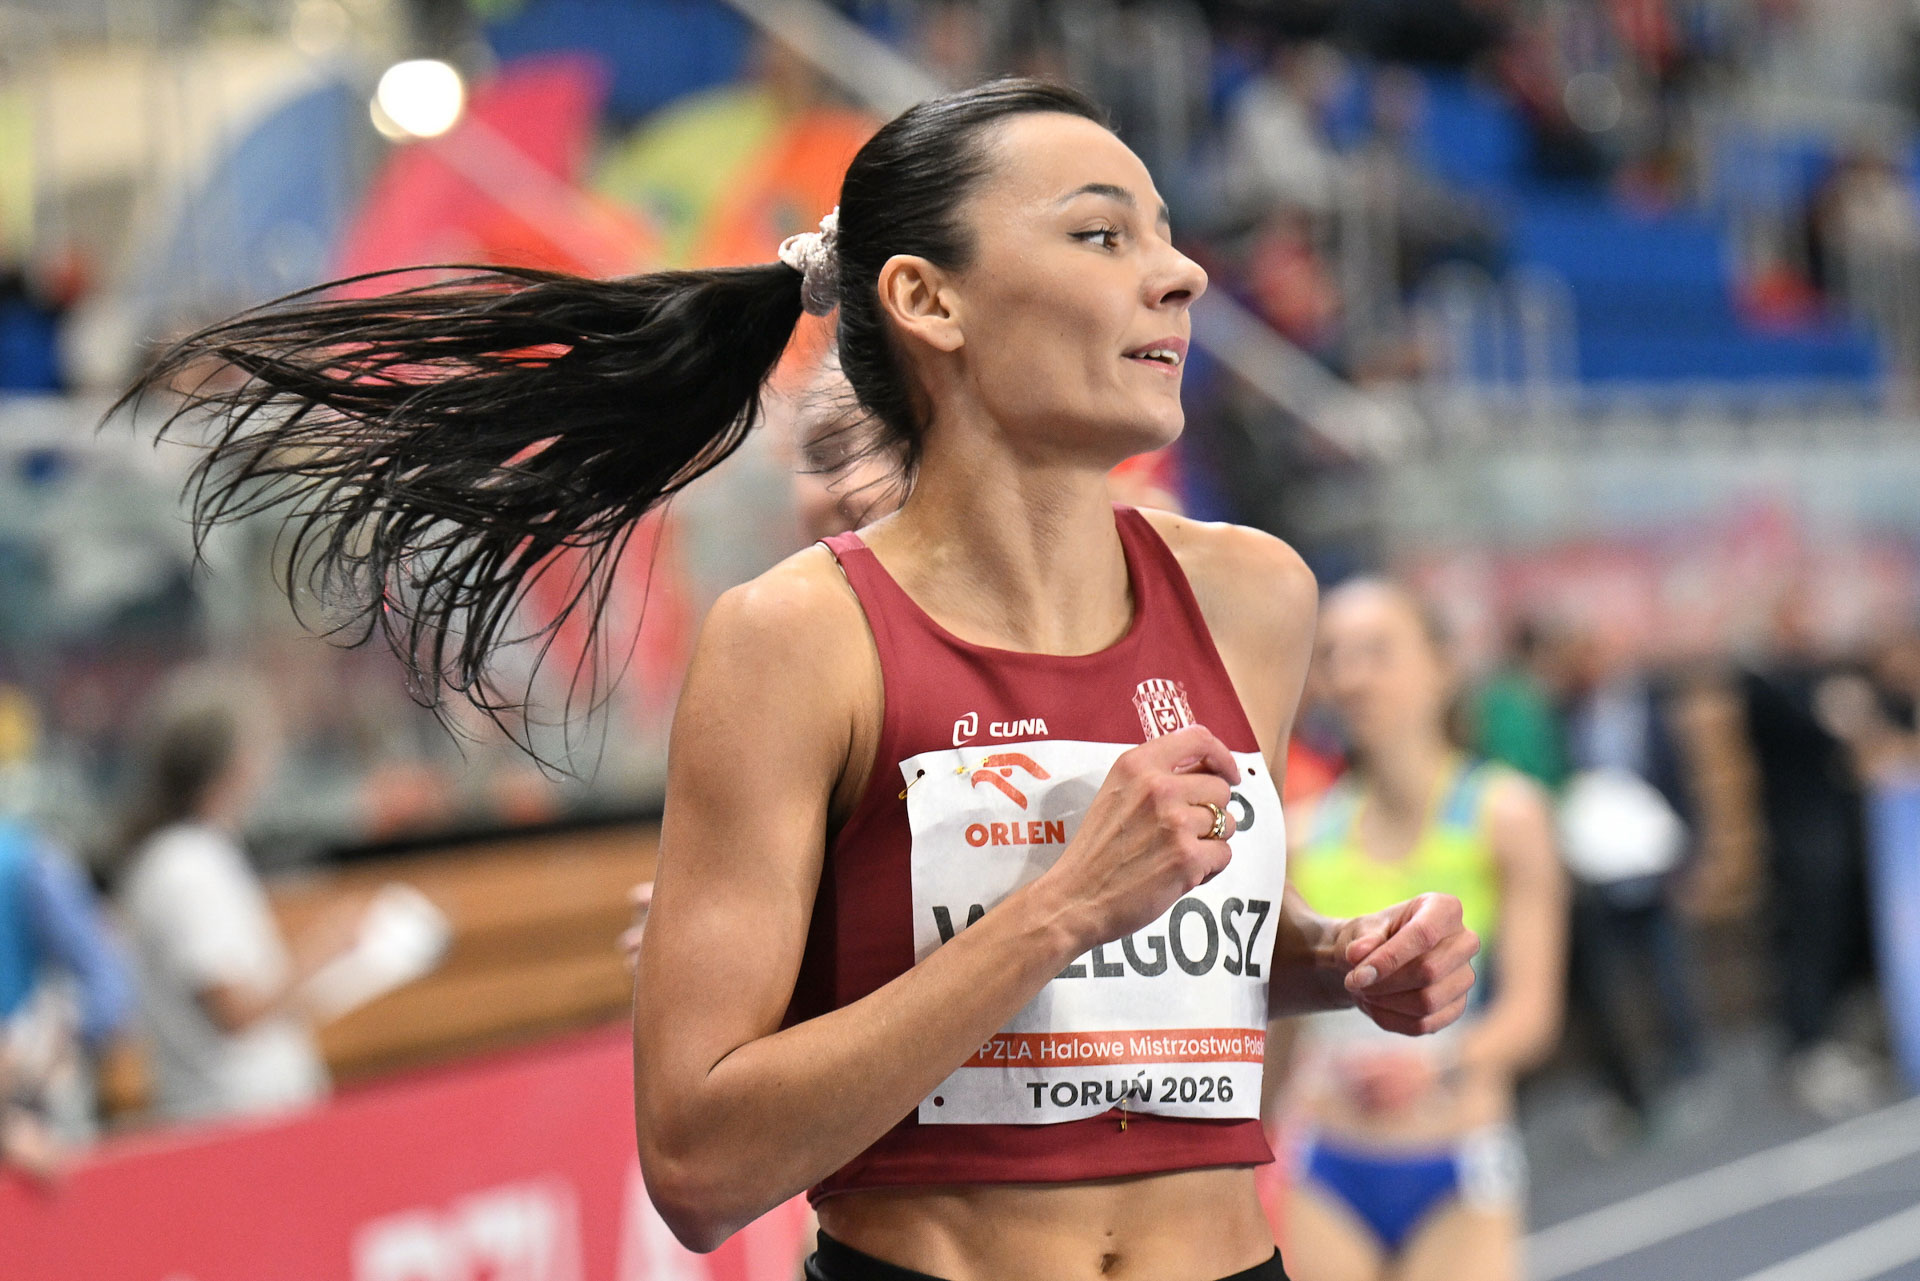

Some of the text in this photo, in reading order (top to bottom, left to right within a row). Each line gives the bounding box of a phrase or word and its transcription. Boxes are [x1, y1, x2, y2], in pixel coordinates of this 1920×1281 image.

[989, 718, 1049, 737] CUNA
[965, 821, 1066, 848] ORLEN
[979, 1040, 1033, 1060] PZLA
[1040, 1038, 1125, 1059] Halowe
[1129, 1035, 1242, 1057] Mistrzostwa
[1026, 1070, 1234, 1109] TORUŃ 2026
